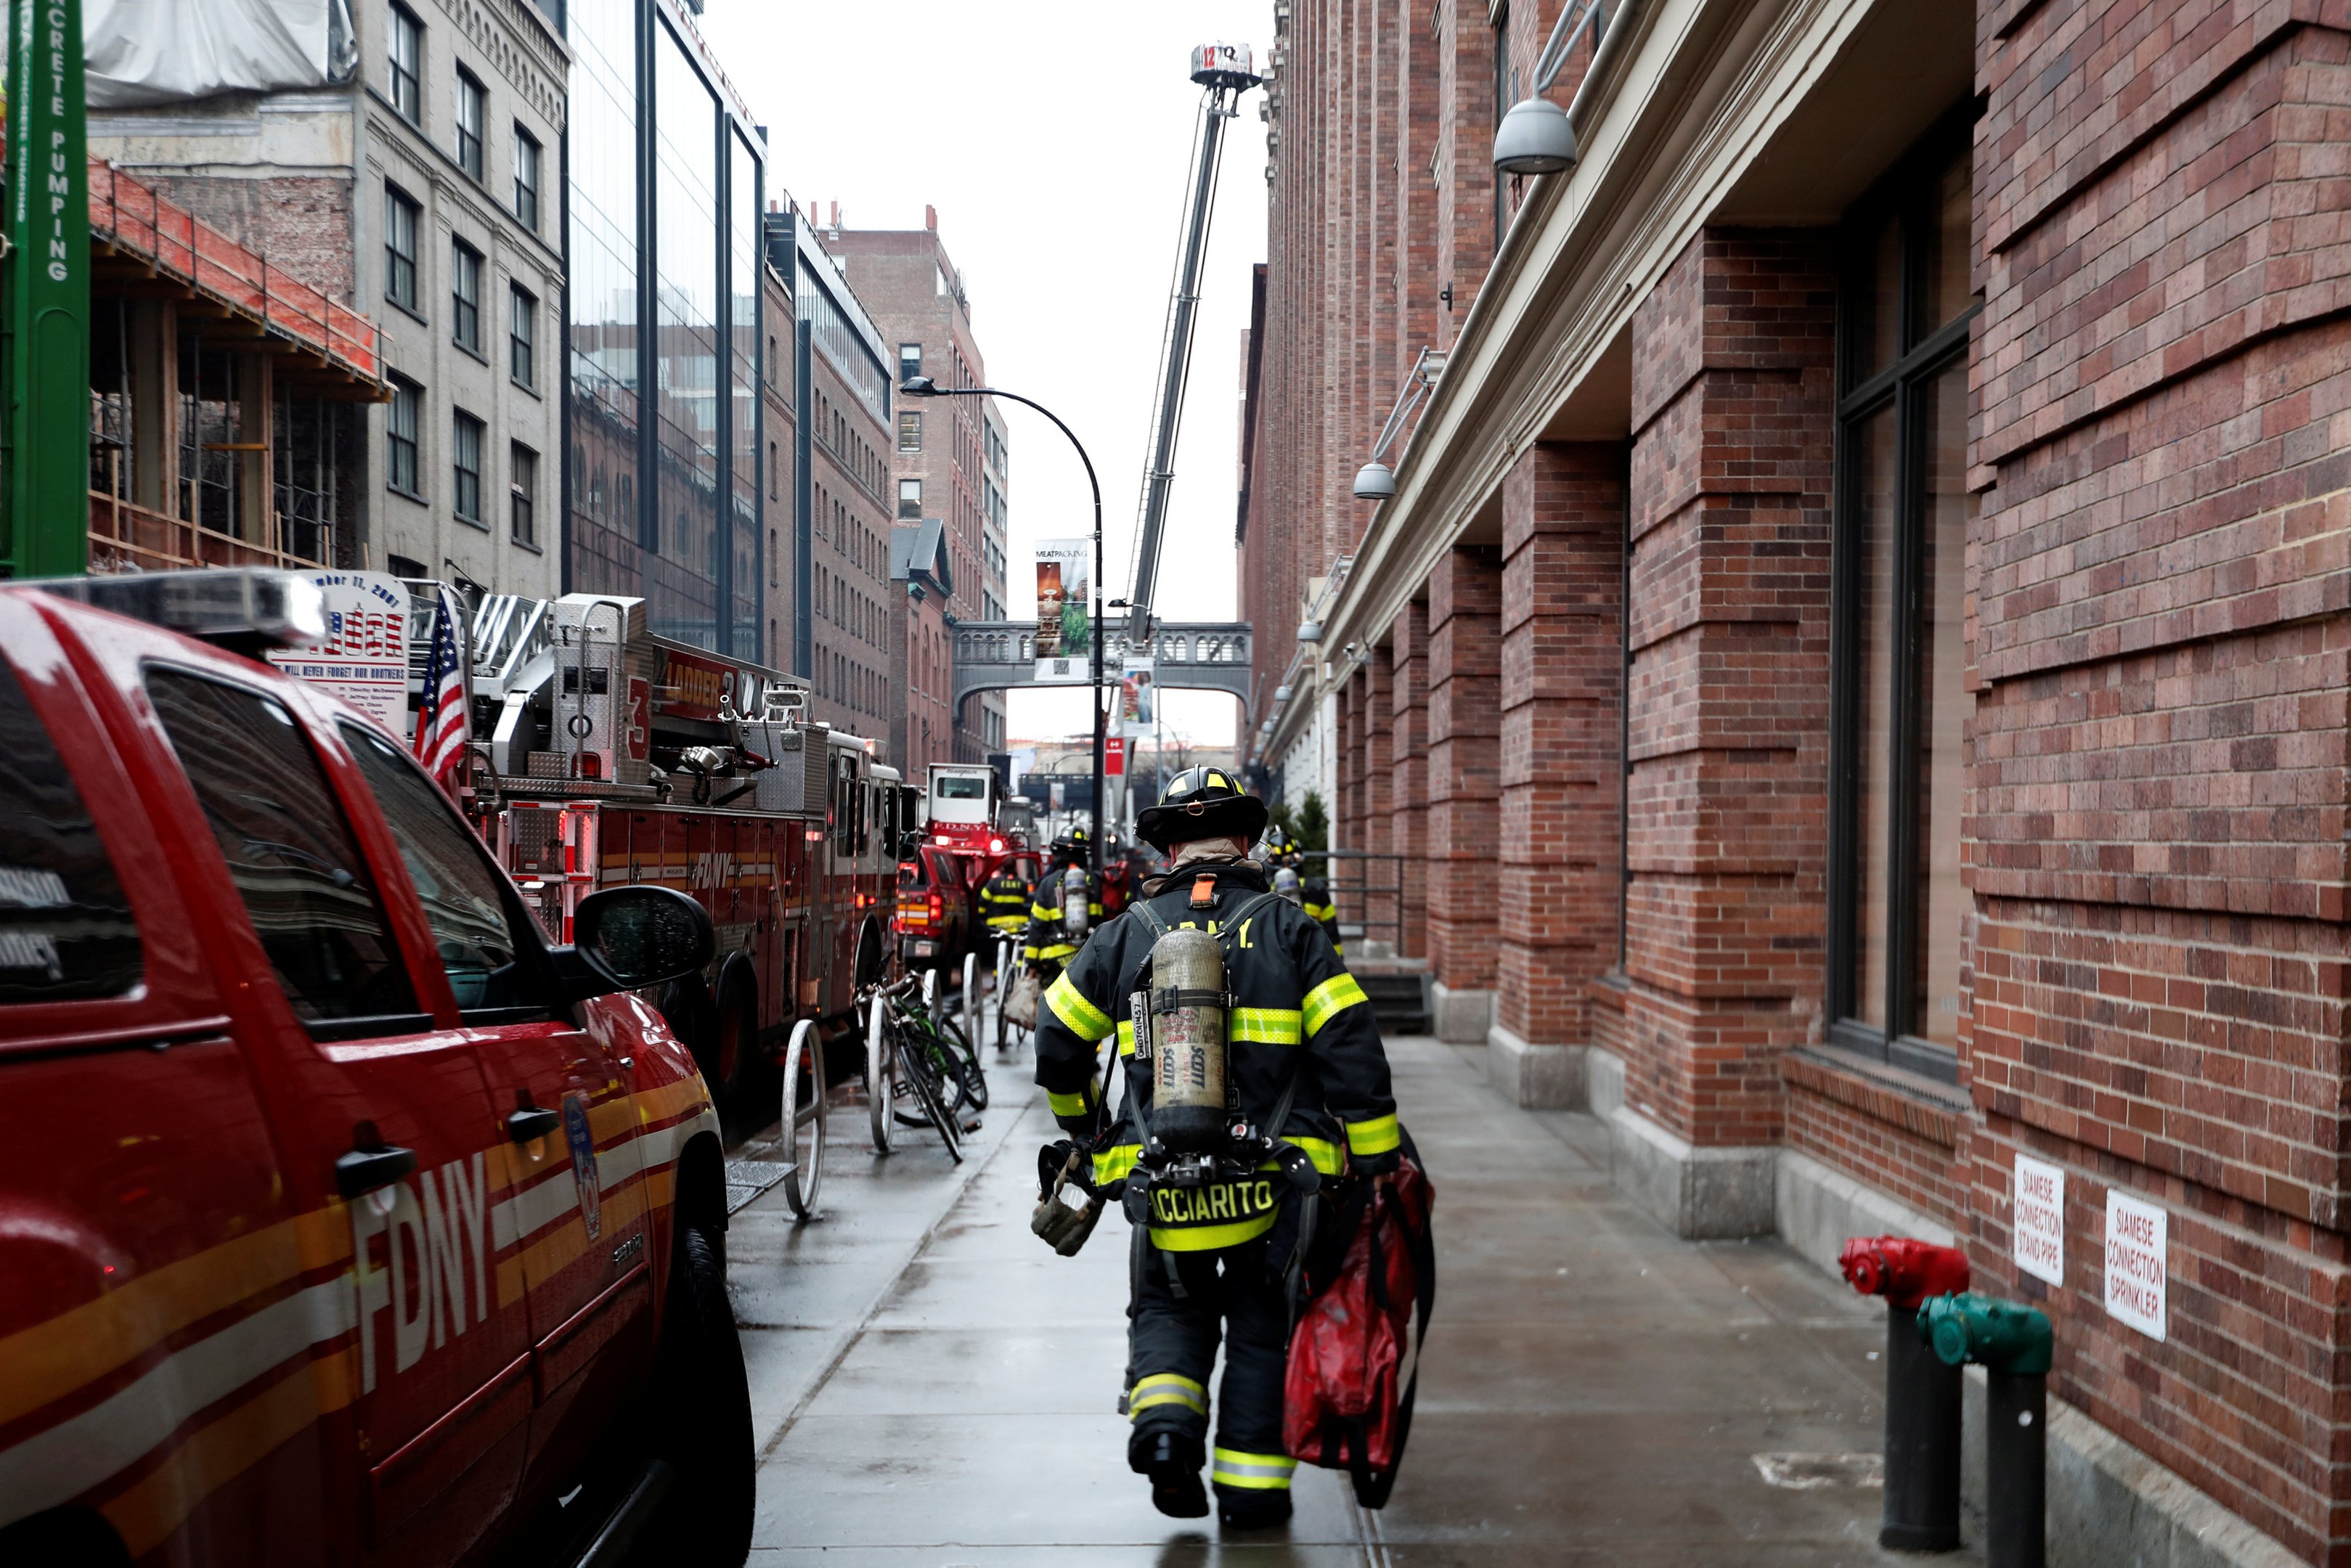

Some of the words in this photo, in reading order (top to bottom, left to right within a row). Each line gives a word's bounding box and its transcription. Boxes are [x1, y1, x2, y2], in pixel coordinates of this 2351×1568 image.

[1204, 46, 1215, 68] 12
[48, 131, 68, 282] PUMPING
[372, 584, 400, 608] 2001
[303, 666, 324, 677] NEVER
[327, 667, 351, 679] FORGET
[355, 667, 368, 679] OUR
[371, 668, 404, 680] BROTHERS
[666, 662, 720, 709] LADDER
[627, 675, 651, 761] 3
[696, 852, 732, 889] FDNY
[1163, 1047, 1175, 1089] SCOTT
[1191, 1045, 1205, 1089] SCOTT
[2023, 1167, 2053, 1204] SIAMESE
[2016, 1199, 2061, 1240] CONNECTION
[2116, 1208, 2154, 1248] SIAMESE
[2018, 1230, 2040, 1261] STAND
[2042, 1241, 2058, 1270] PIPE
[2107, 1239, 2163, 1289] CONNECTION
[351, 1151, 488, 1396] FDNY
[2110, 1275, 2158, 1323] SPRINKLER
